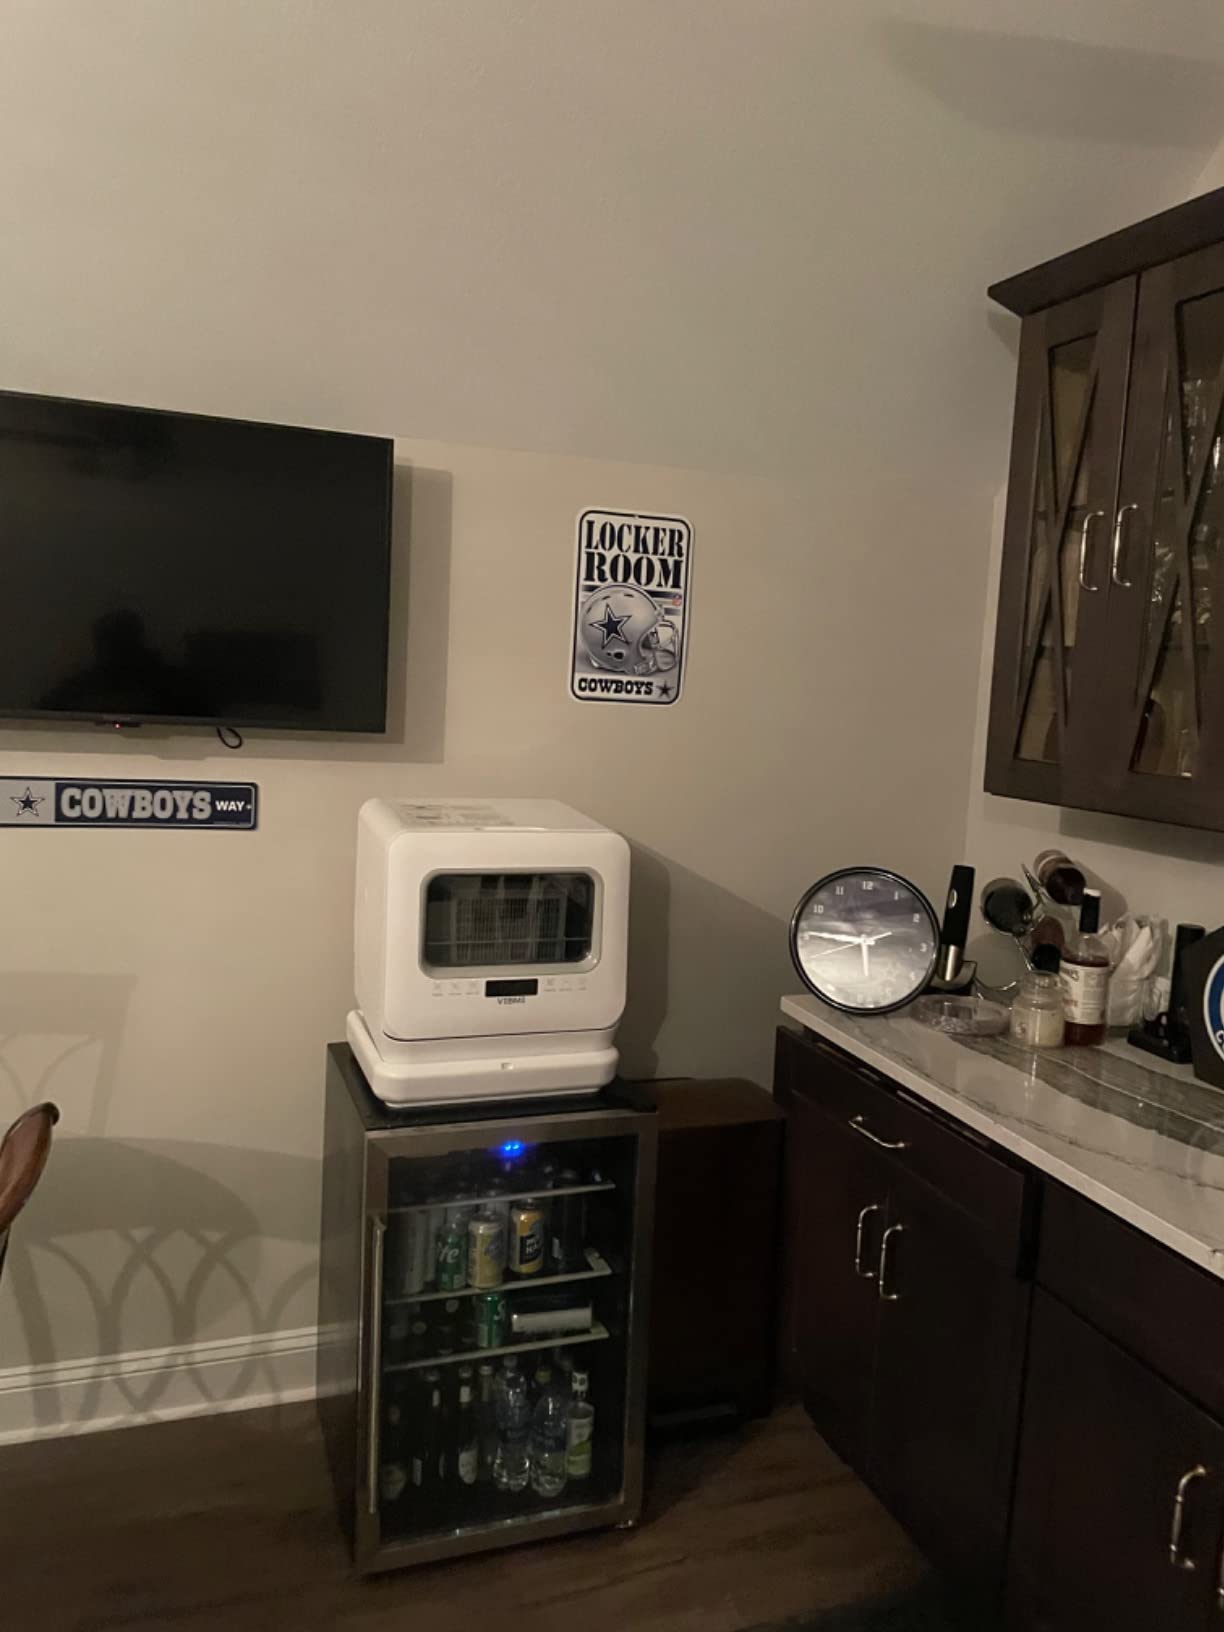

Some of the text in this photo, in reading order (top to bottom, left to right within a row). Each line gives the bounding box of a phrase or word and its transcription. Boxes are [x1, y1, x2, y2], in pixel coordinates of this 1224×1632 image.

[584, 519, 684, 558] LOCKER
[583, 551, 684, 589] ROOM
[578, 678, 653, 695] COWBOYS
[60, 787, 245, 820] COWBOYS WAY
[835, 886, 844, 895] 11
[862, 881, 874, 890] 12
[813, 904, 824, 913] 10
